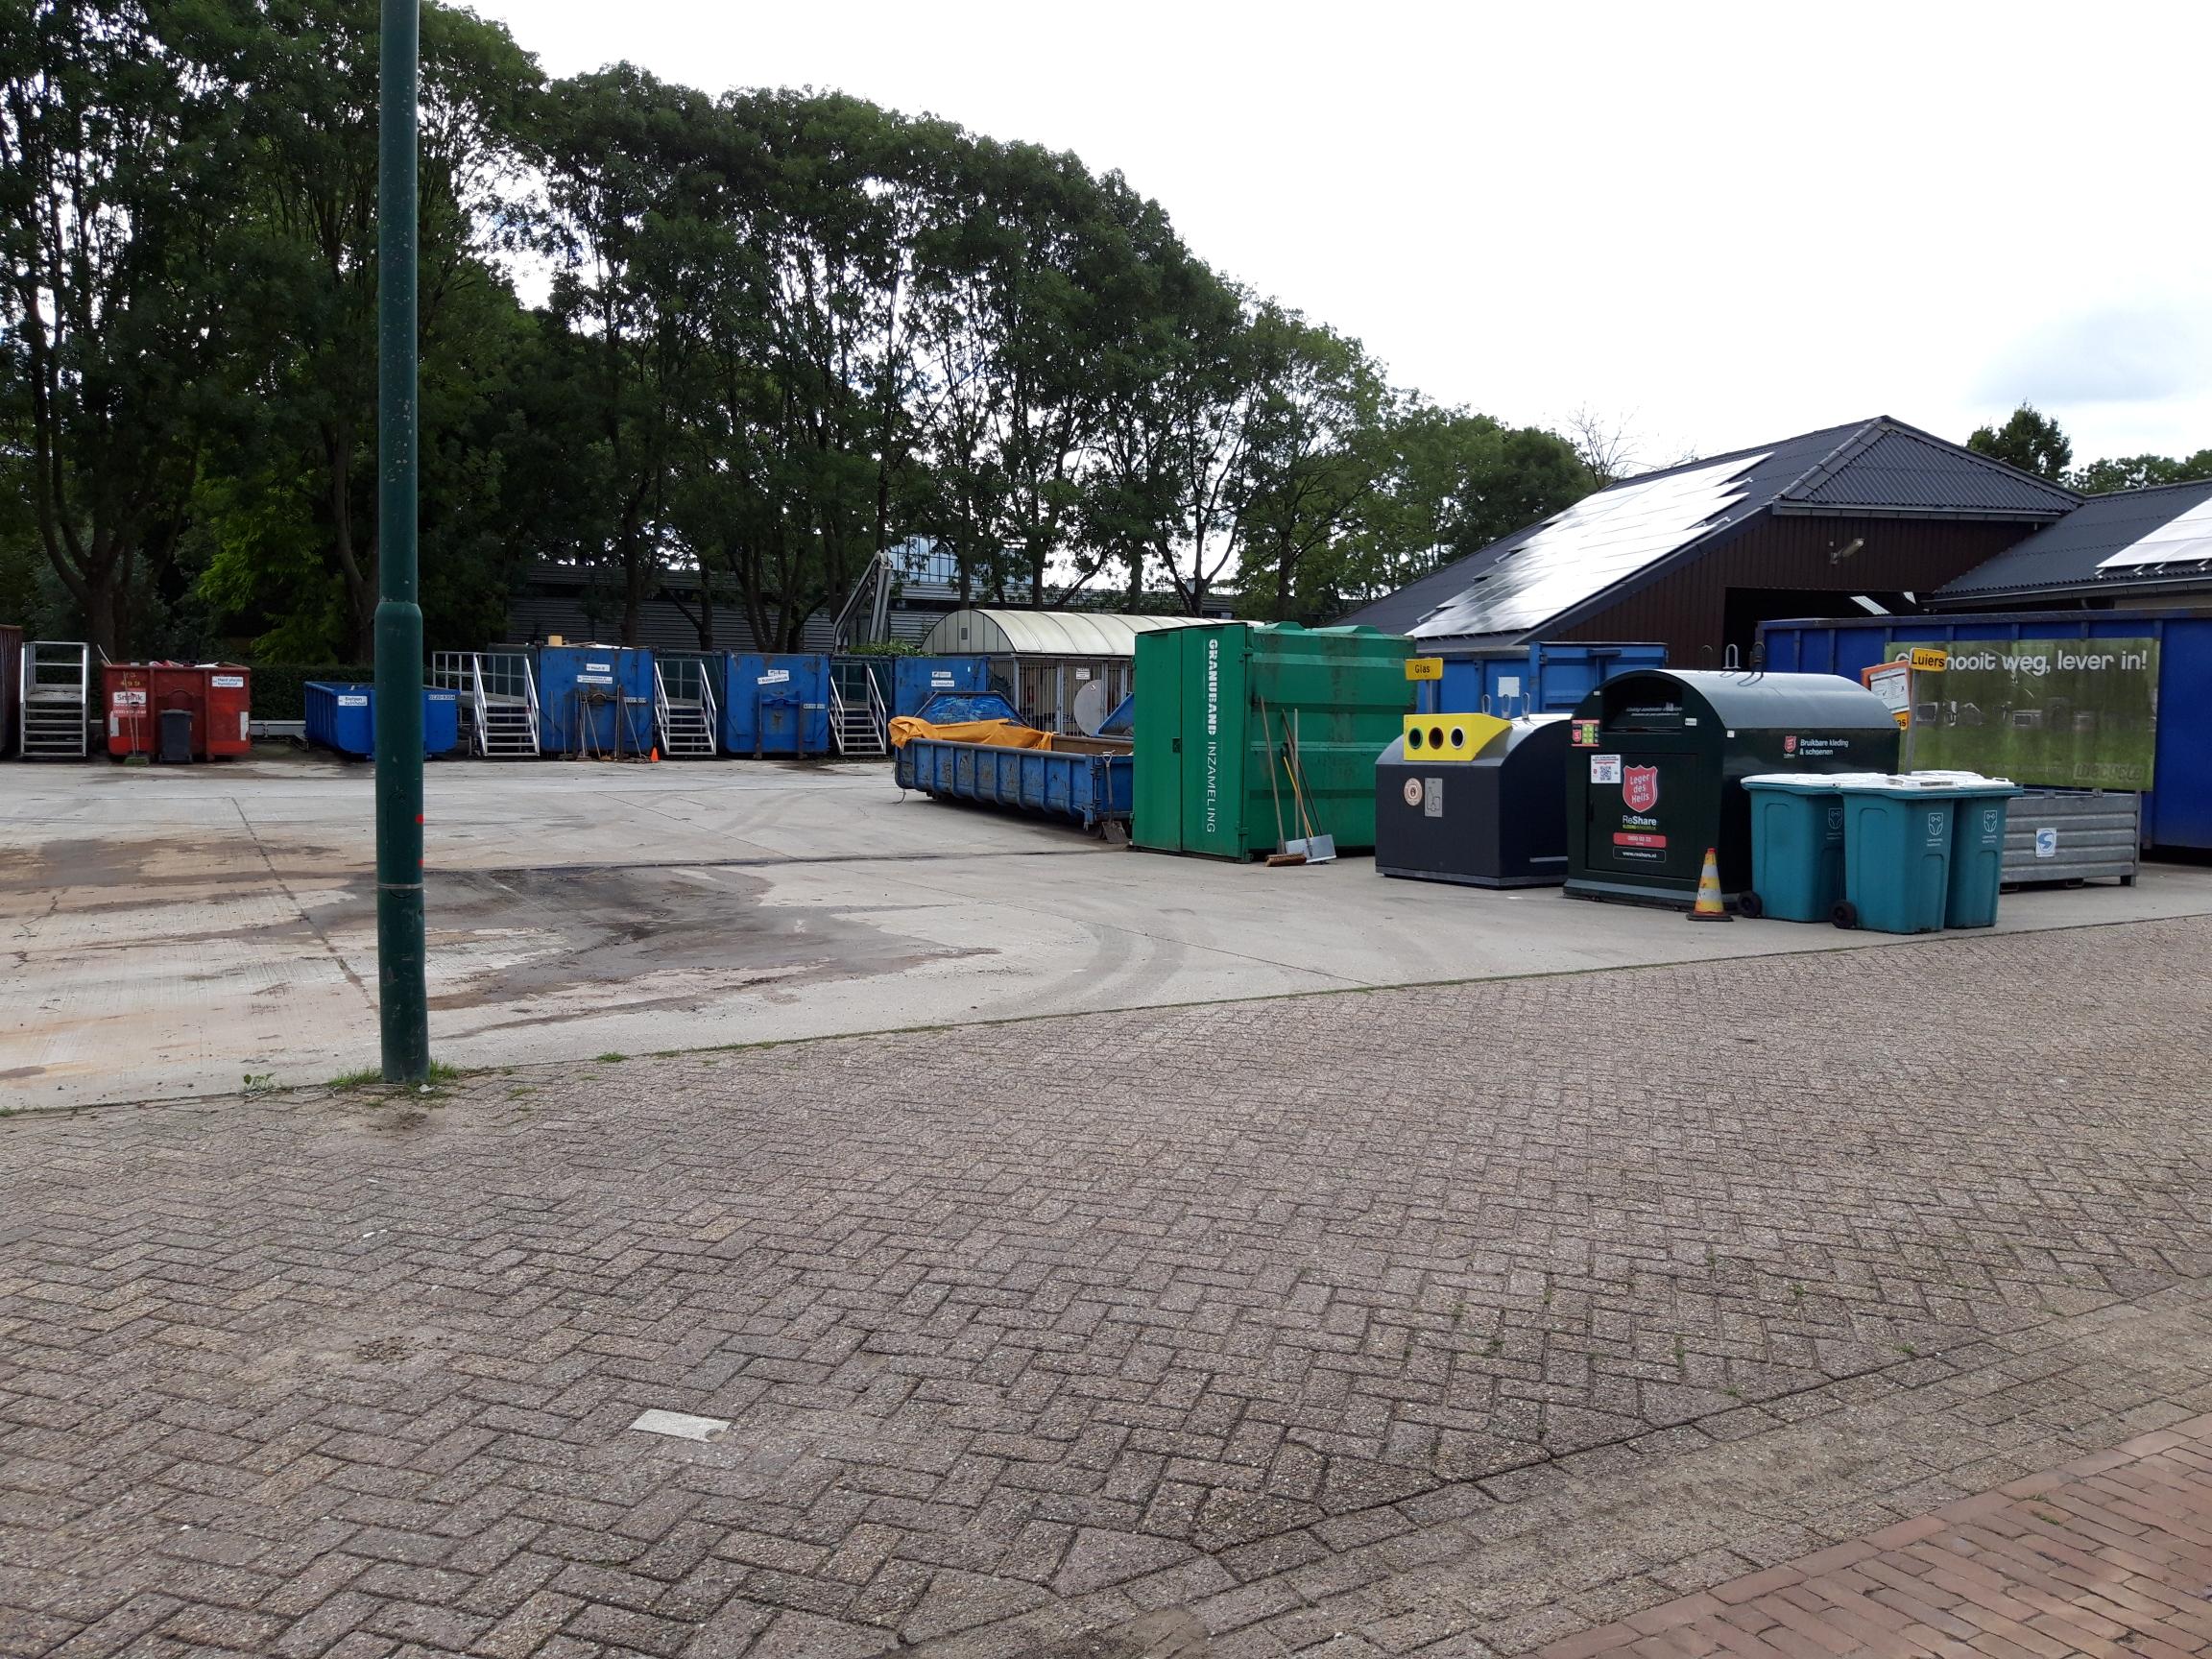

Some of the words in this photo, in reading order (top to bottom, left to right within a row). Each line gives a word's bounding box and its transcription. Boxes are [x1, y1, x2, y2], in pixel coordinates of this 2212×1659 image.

[1911, 653, 1945, 667] Luiers
[1945, 652, 1997, 670] nooit
[2002, 654, 2051, 677] weg,
[2057, 650, 2115, 670] lever
[2121, 650, 2147, 670] in!
[1414, 663, 1431, 673] Glas
[1208, 638, 1218, 735] GRANUBAND
[1800, 738, 1828, 747] Bruikbare
[1829, 738, 1849, 748] kleding
[1629, 774, 1650, 785] Leger
[1206, 741, 1216, 833] INZAMELING
[1633, 784, 1646, 794] des
[1631, 793, 1650, 804] Heils
[1623, 814, 1657, 826] ReShare
